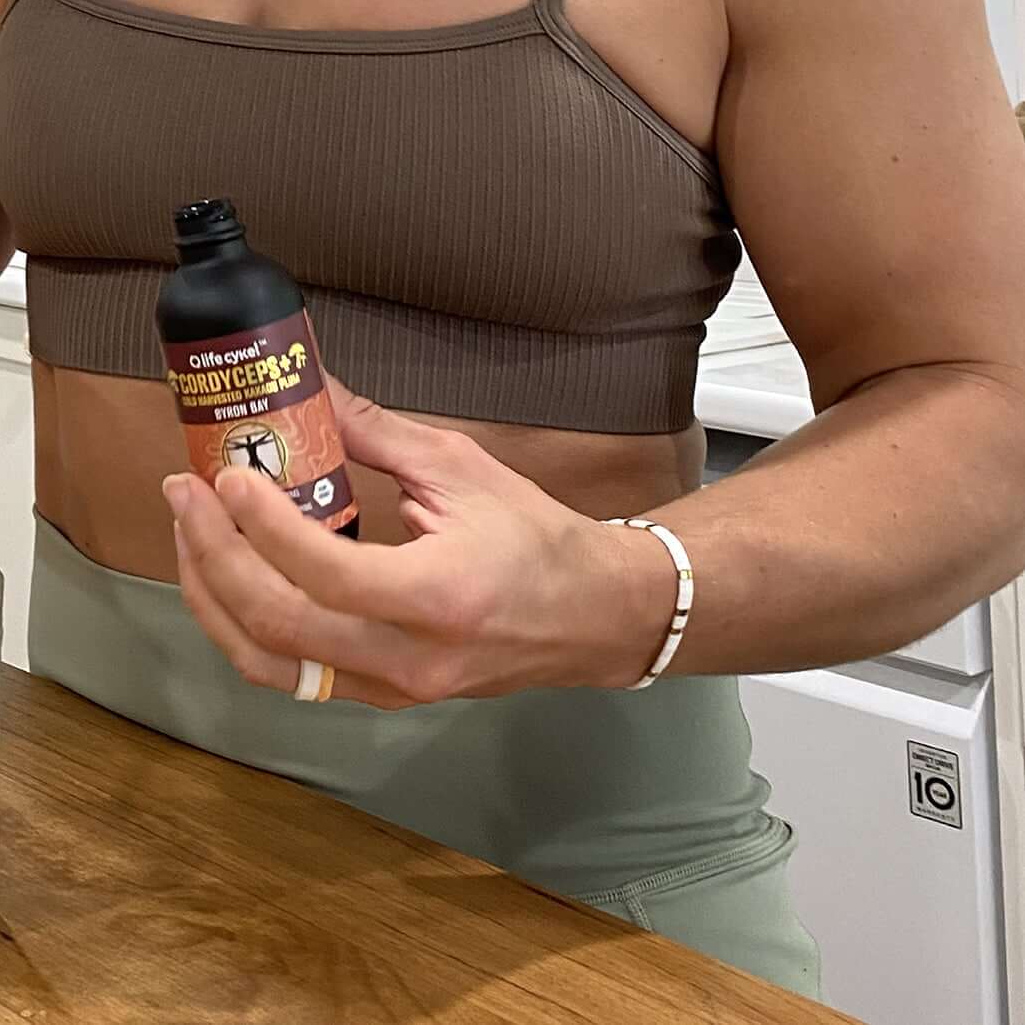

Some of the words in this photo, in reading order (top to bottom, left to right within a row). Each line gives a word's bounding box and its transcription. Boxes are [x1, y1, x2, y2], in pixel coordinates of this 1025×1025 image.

[214, 404, 247, 421] BYRON
[250, 398, 269, 415] BAY
[915, 772, 955, 810] 10
